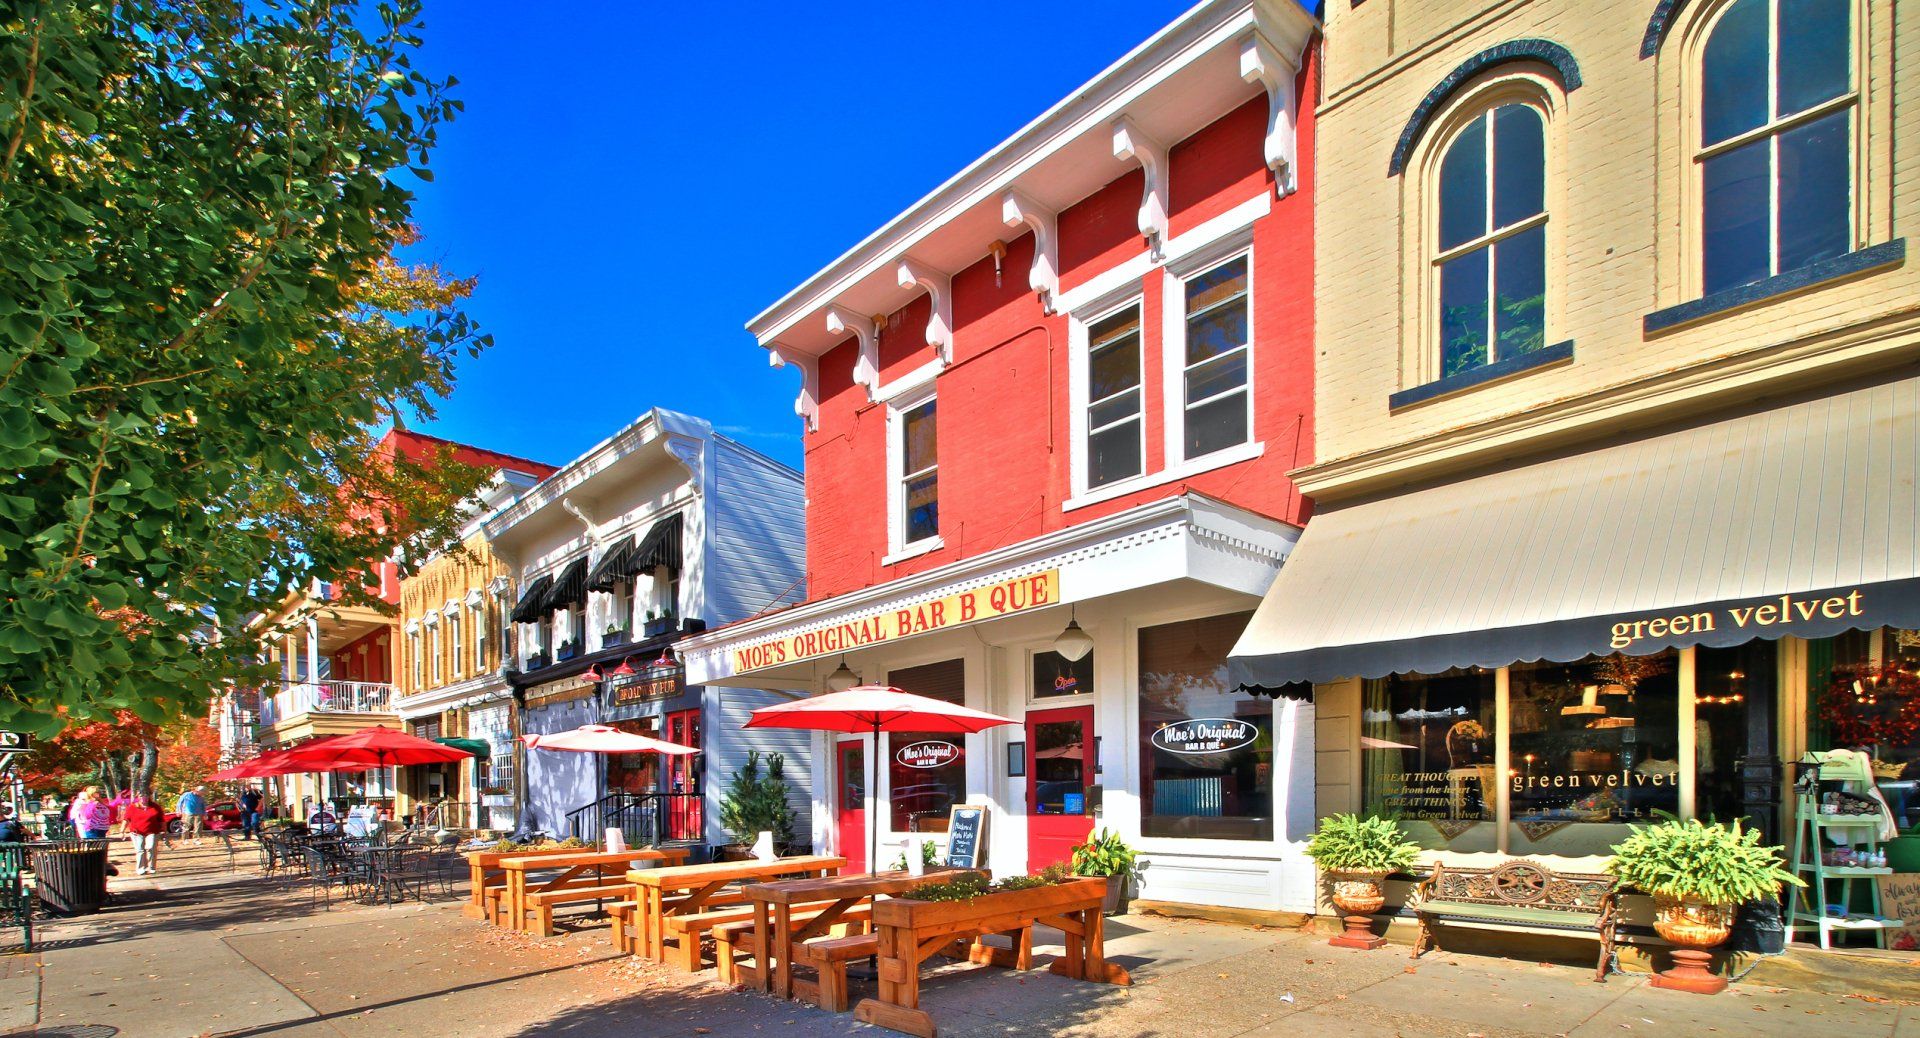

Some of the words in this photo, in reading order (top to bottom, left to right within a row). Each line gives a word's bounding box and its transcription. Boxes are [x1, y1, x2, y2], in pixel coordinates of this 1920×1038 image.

[737, 640, 786, 671] MOE'S
[793, 616, 887, 656] ORIGINAL
[897, 600, 946, 636] BAR
[959, 593, 977, 622] B
[989, 574, 1048, 613] QUE
[1609, 611, 1716, 649] green
[1728, 589, 1864, 628] velvet
[660, 679, 676, 693] PUB
[1055, 676, 1077, 690] Open
[1164, 726, 1195, 743] Moe's
[1197, 723, 1246, 742] Original
[904, 747, 923, 760] Moe's
[923, 744, 952, 759] Original
[1185, 742, 1199, 750] BAR
[1200, 742, 1206, 750] B
[1206, 741, 1220, 750] QUE
[1513, 772, 1581, 792] green
[1590, 769, 1677, 787] velvet
[1400, 786, 1424, 795] from
[1425, 785, 1442, 794] the
[1417, 809, 1447, 818] Green
